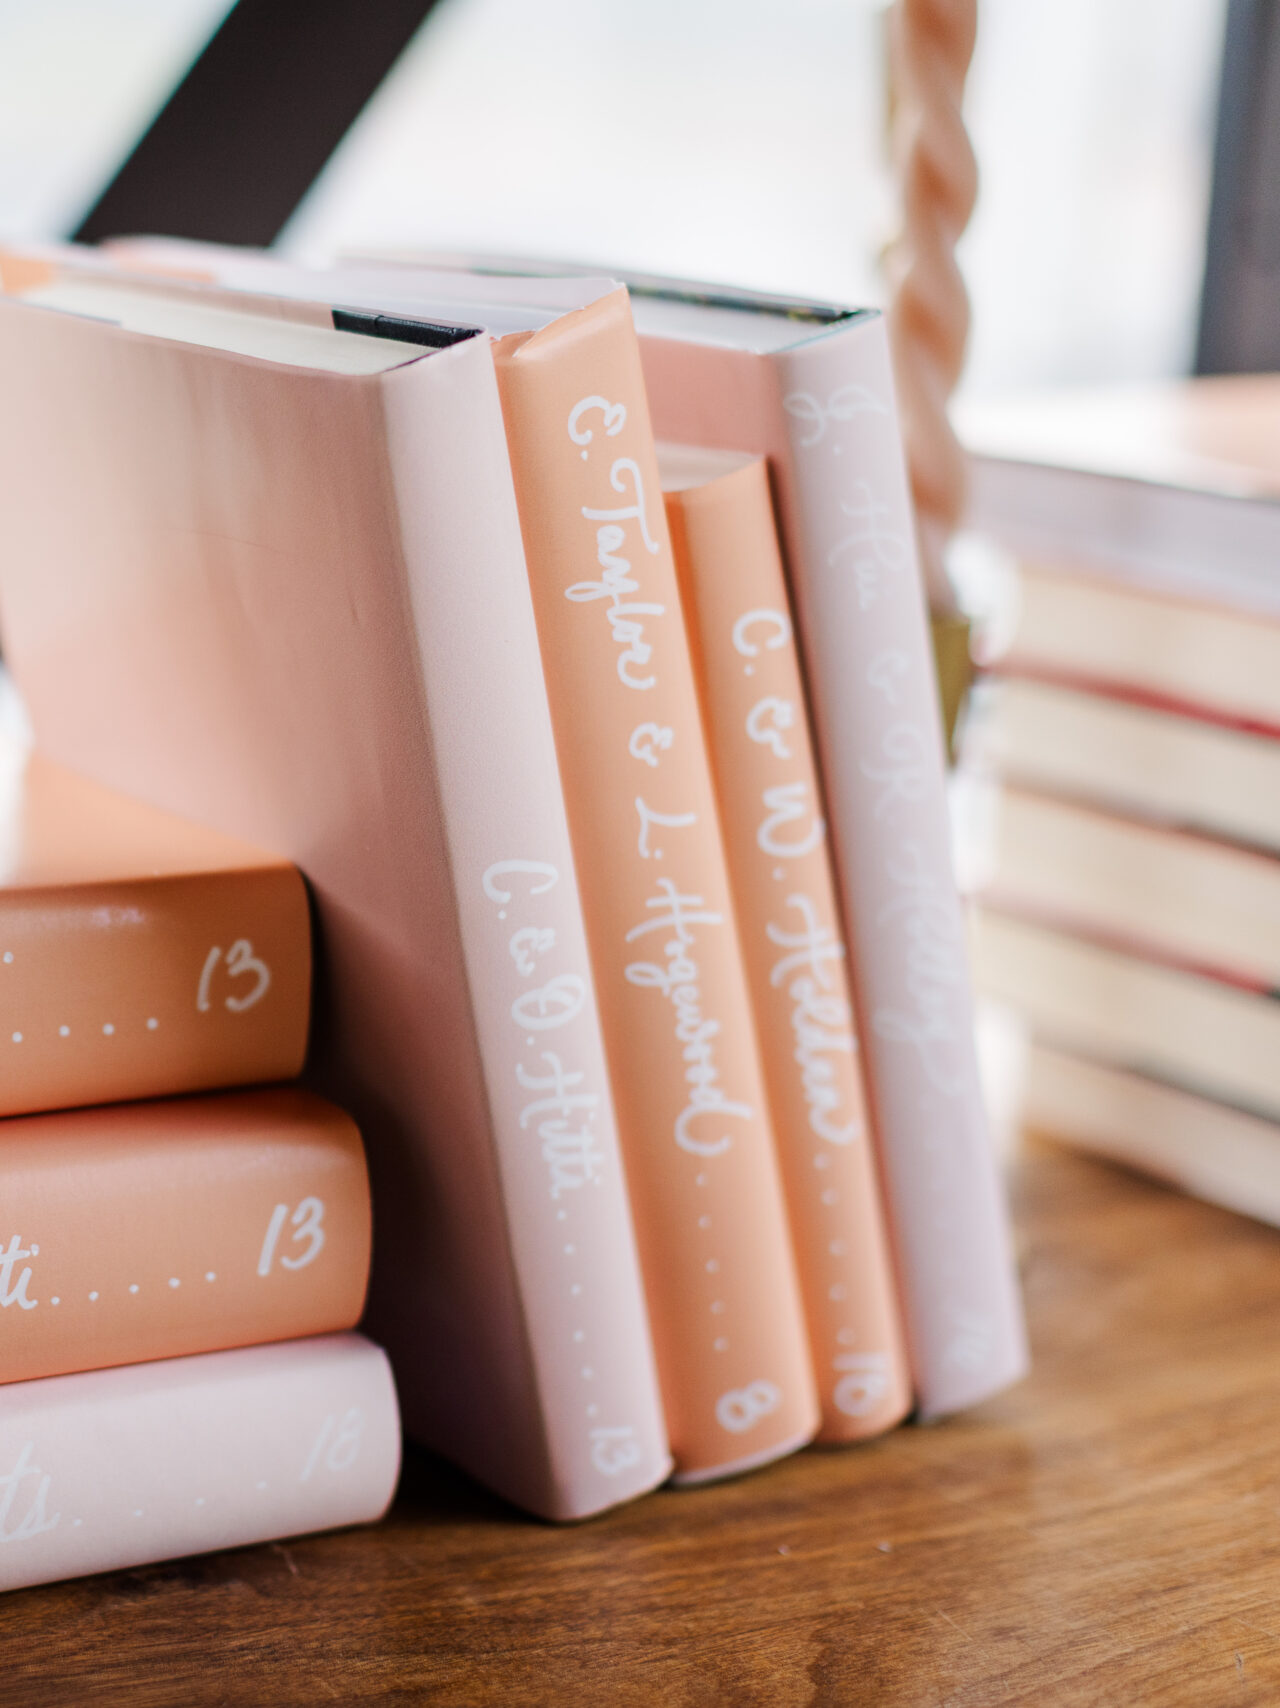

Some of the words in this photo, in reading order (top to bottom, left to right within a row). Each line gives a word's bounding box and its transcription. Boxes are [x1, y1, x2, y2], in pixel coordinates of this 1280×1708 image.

[197, 939, 272, 1012] 13
[564, 457, 666, 689] Taylor
[715, 1379, 780, 1433] 8
[256, 1196, 326, 1278] 13
[589, 1425, 640, 1475] 13
